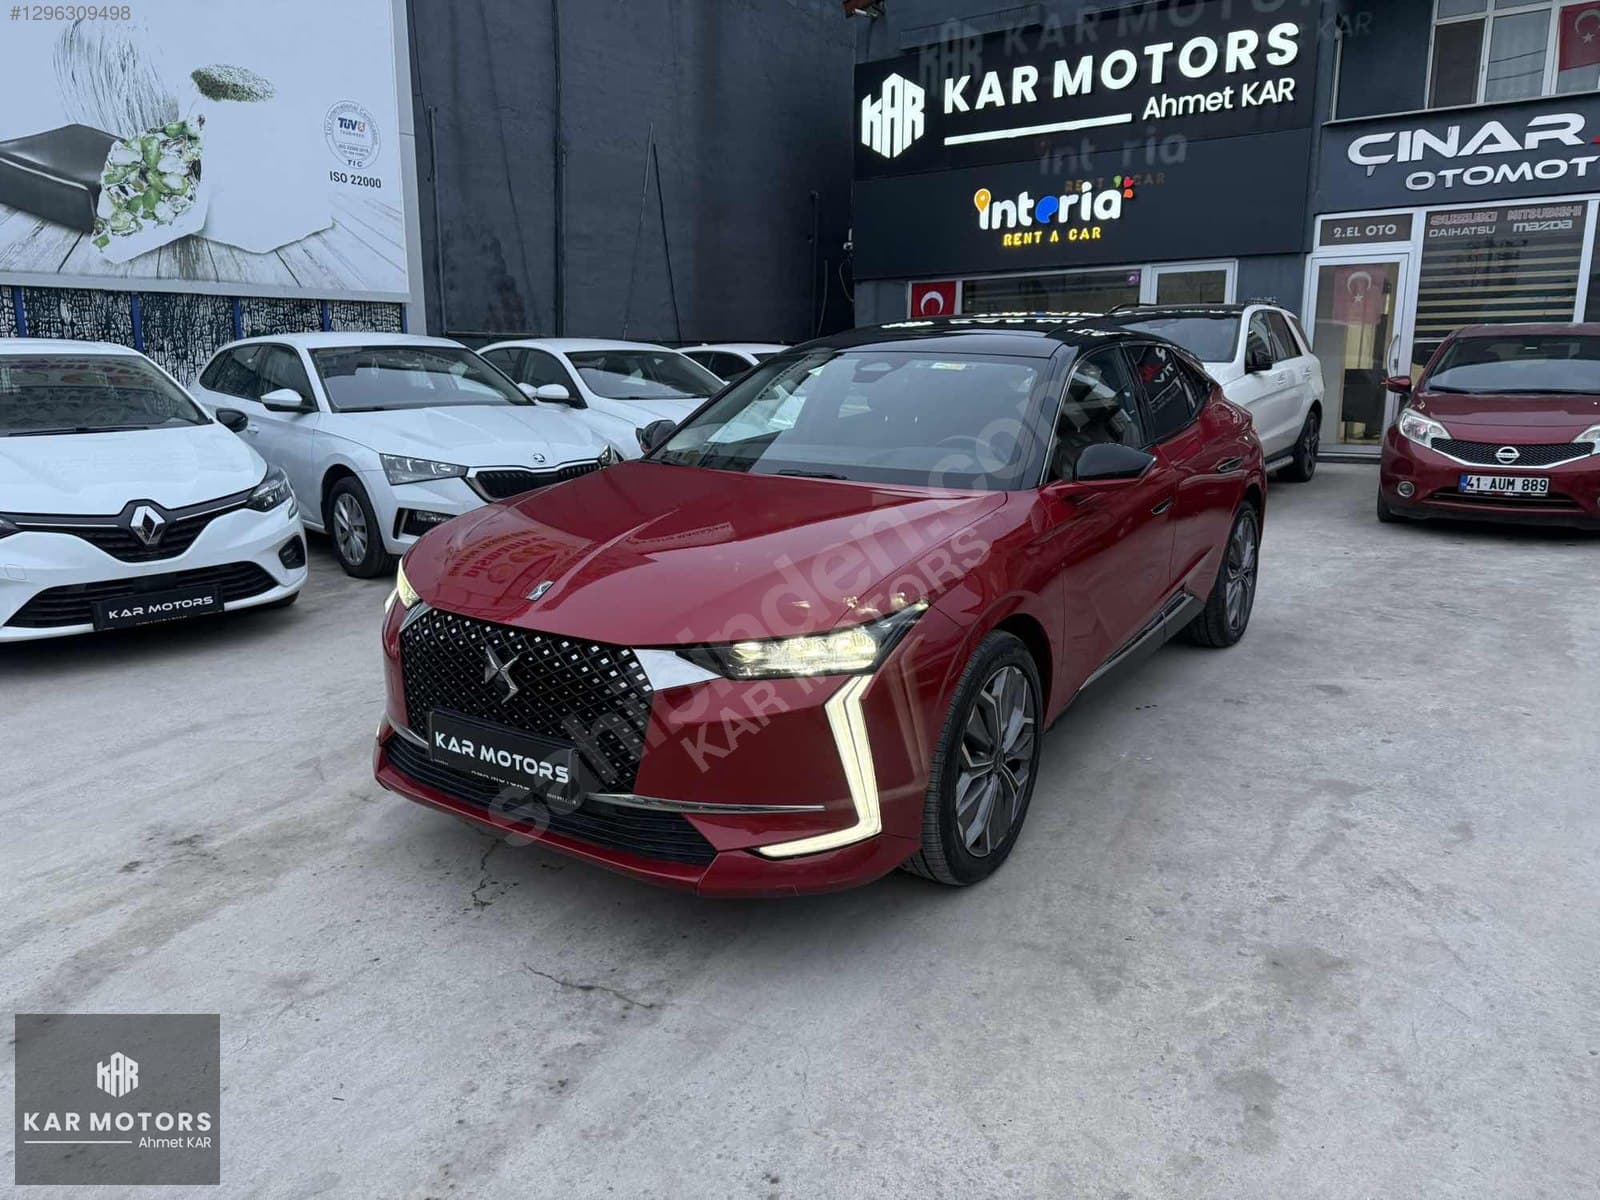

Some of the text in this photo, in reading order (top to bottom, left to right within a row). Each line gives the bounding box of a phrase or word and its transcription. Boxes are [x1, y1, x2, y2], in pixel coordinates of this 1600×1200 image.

[943, 22, 1300, 114] KAR MOTORS
[1142, 77, 1295, 120] Ahmet KAR
[861, 72, 926, 159] KAR
[1348, 113, 1586, 177] ÇINAR
[347, 159, 363, 168] TIC
[1405, 155, 1600, 191] OTOMOT
[329, 170, 382, 189] ISO 22000
[974, 181, 1122, 230] interia
[1003, 227, 1102, 247] RENT A CAR
[1333, 223, 1397, 239] 2.EL OTO
[1428, 225, 1496, 238] DAIHATSU
[1467, 477, 1481, 489] 41
[1489, 477, 1516, 491] AUM
[1521, 478, 1548, 492] 889
[108, 595, 214, 620] KAR MOTORS
[435, 731, 475, 758] KAR
[480, 744, 569, 784] MOTORS
